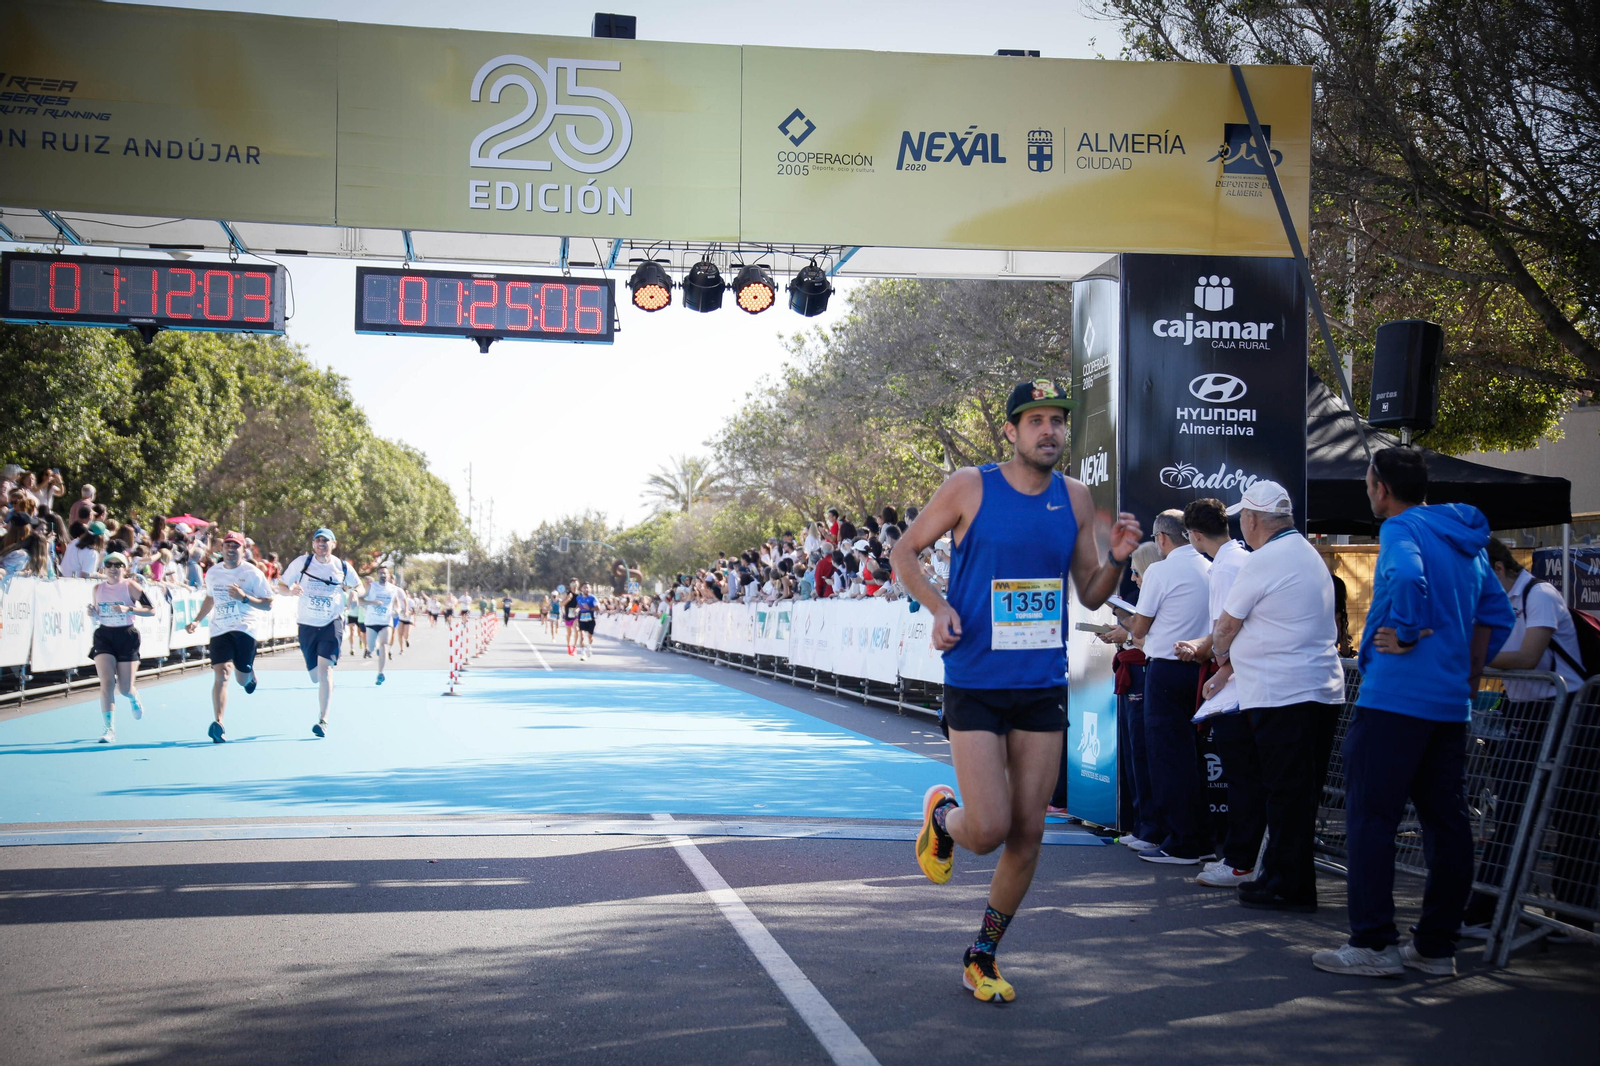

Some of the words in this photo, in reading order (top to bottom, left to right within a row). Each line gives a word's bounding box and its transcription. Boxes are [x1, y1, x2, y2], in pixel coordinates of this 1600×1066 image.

[6, 75, 79, 93] RFEA
[0, 91, 71, 107] SERIES
[42, 108, 112, 121] RUNNING
[469, 53, 633, 174] 25
[41, 130, 111, 155] RUIZ
[122, 137, 262, 165] ANDÚJAR
[1076, 129, 1187, 154] ALMERÍA
[777, 151, 873, 167] COOPERACIÓN
[904, 163, 927, 171] 2020
[1076, 156, 1133, 171] CIUDAD
[776, 163, 810, 177] 2005
[1215, 180, 1260, 189] DEPORTES
[469, 178, 633, 216] EDICIÓN
[398, 275, 602, 334] 01:25:06
[1152, 312, 1275, 346] cajamar
[1211, 340, 1236, 349] CAJA
[1238, 341, 1271, 350] RURAL
[1176, 407, 1257, 422] HYUNDAI
[1178, 422, 1254, 436] Almerialva
[310, 598, 331, 608] 5579
[1001, 591, 1056, 612] 1356
[1580, 587, 1600, 603] Alm
